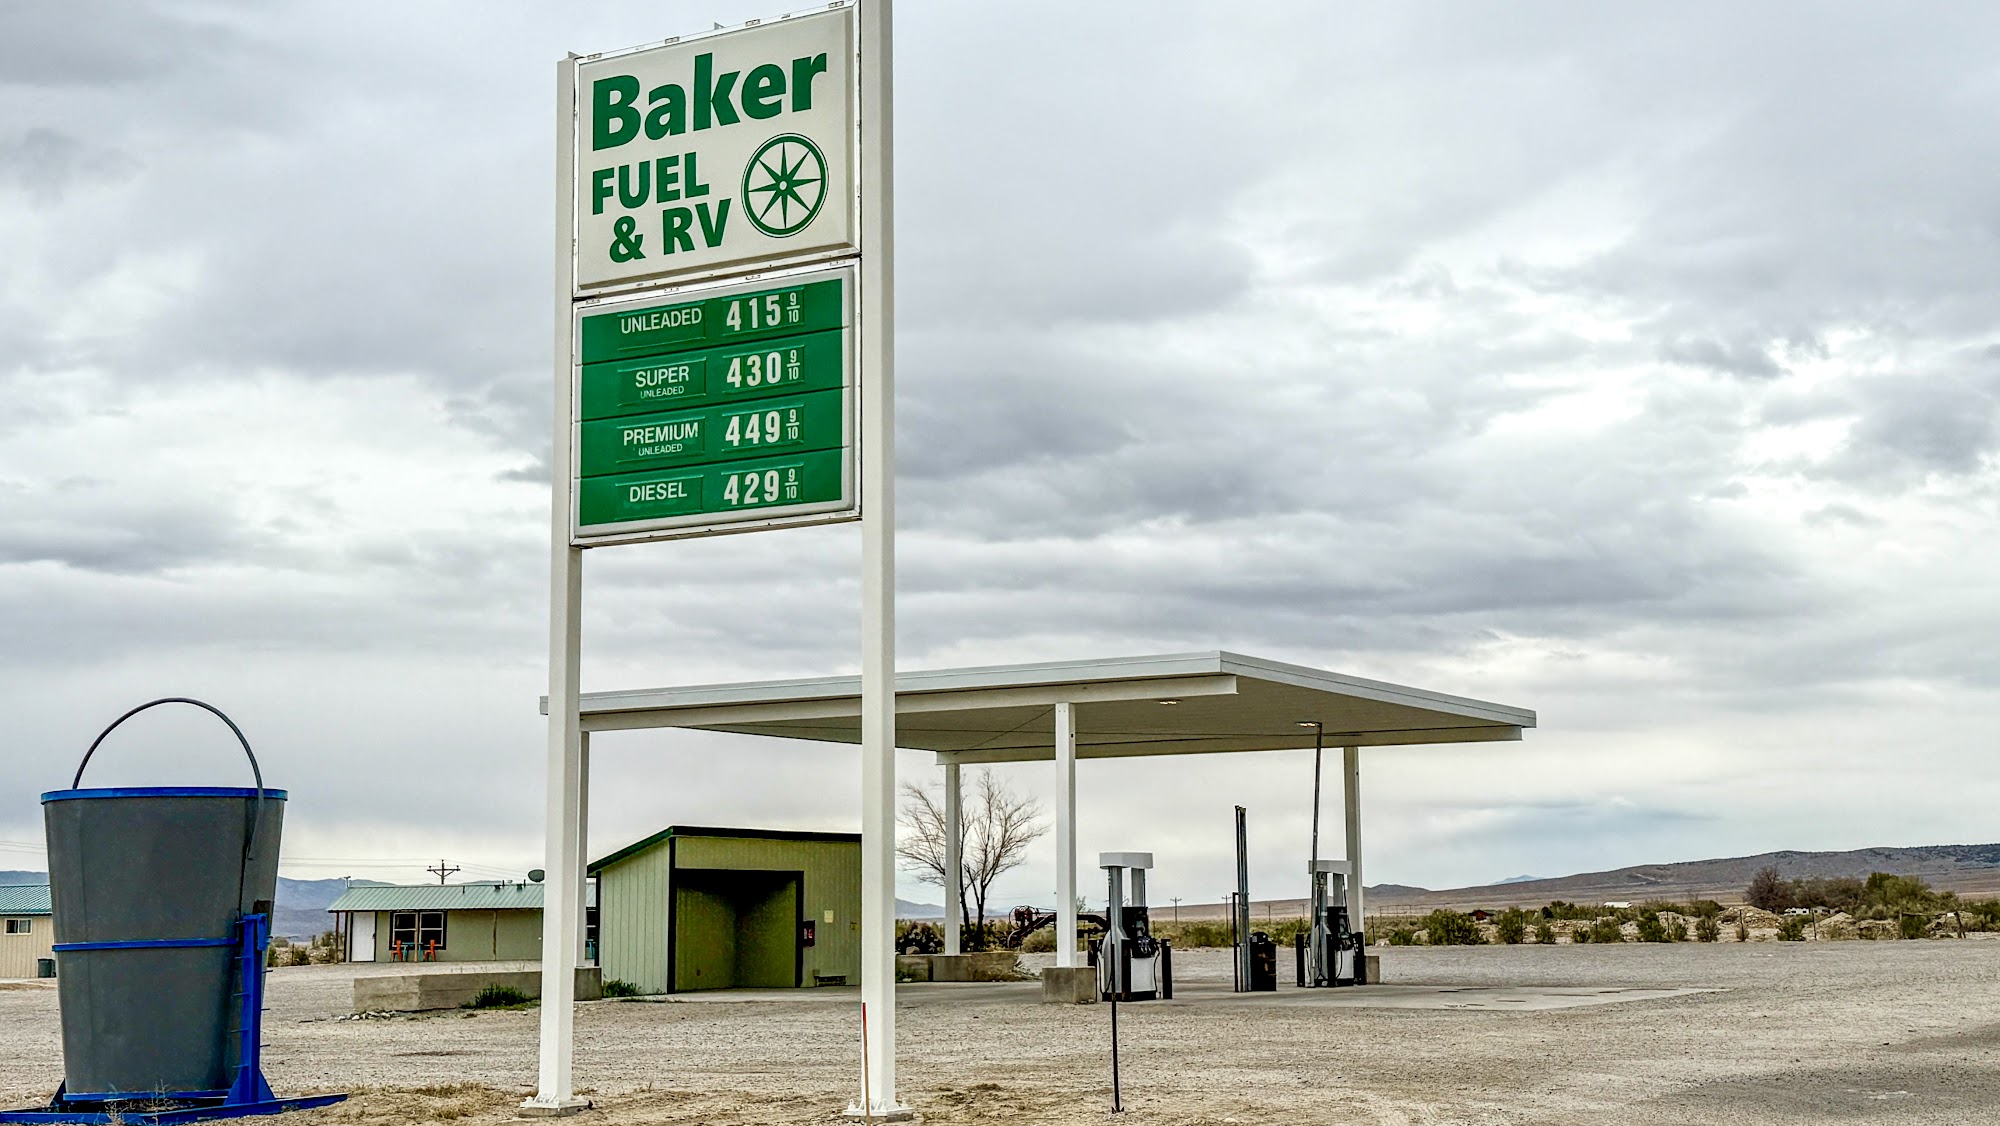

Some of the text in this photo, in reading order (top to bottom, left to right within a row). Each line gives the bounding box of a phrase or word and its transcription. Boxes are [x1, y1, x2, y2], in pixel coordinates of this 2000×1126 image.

[593, 52, 827, 151] Baker
[593, 152, 709, 215] FUEL
[609, 198, 732, 263] & RV
[621, 295, 781, 334] UNLEADED 415
[635, 351, 781, 388] SUPER 430
[640, 385, 685, 399] UNLEADED
[623, 411, 781, 446] PREMIUM 449
[638, 443, 683, 456] UNLEADED
[629, 470, 780, 505] DIESEL 429
